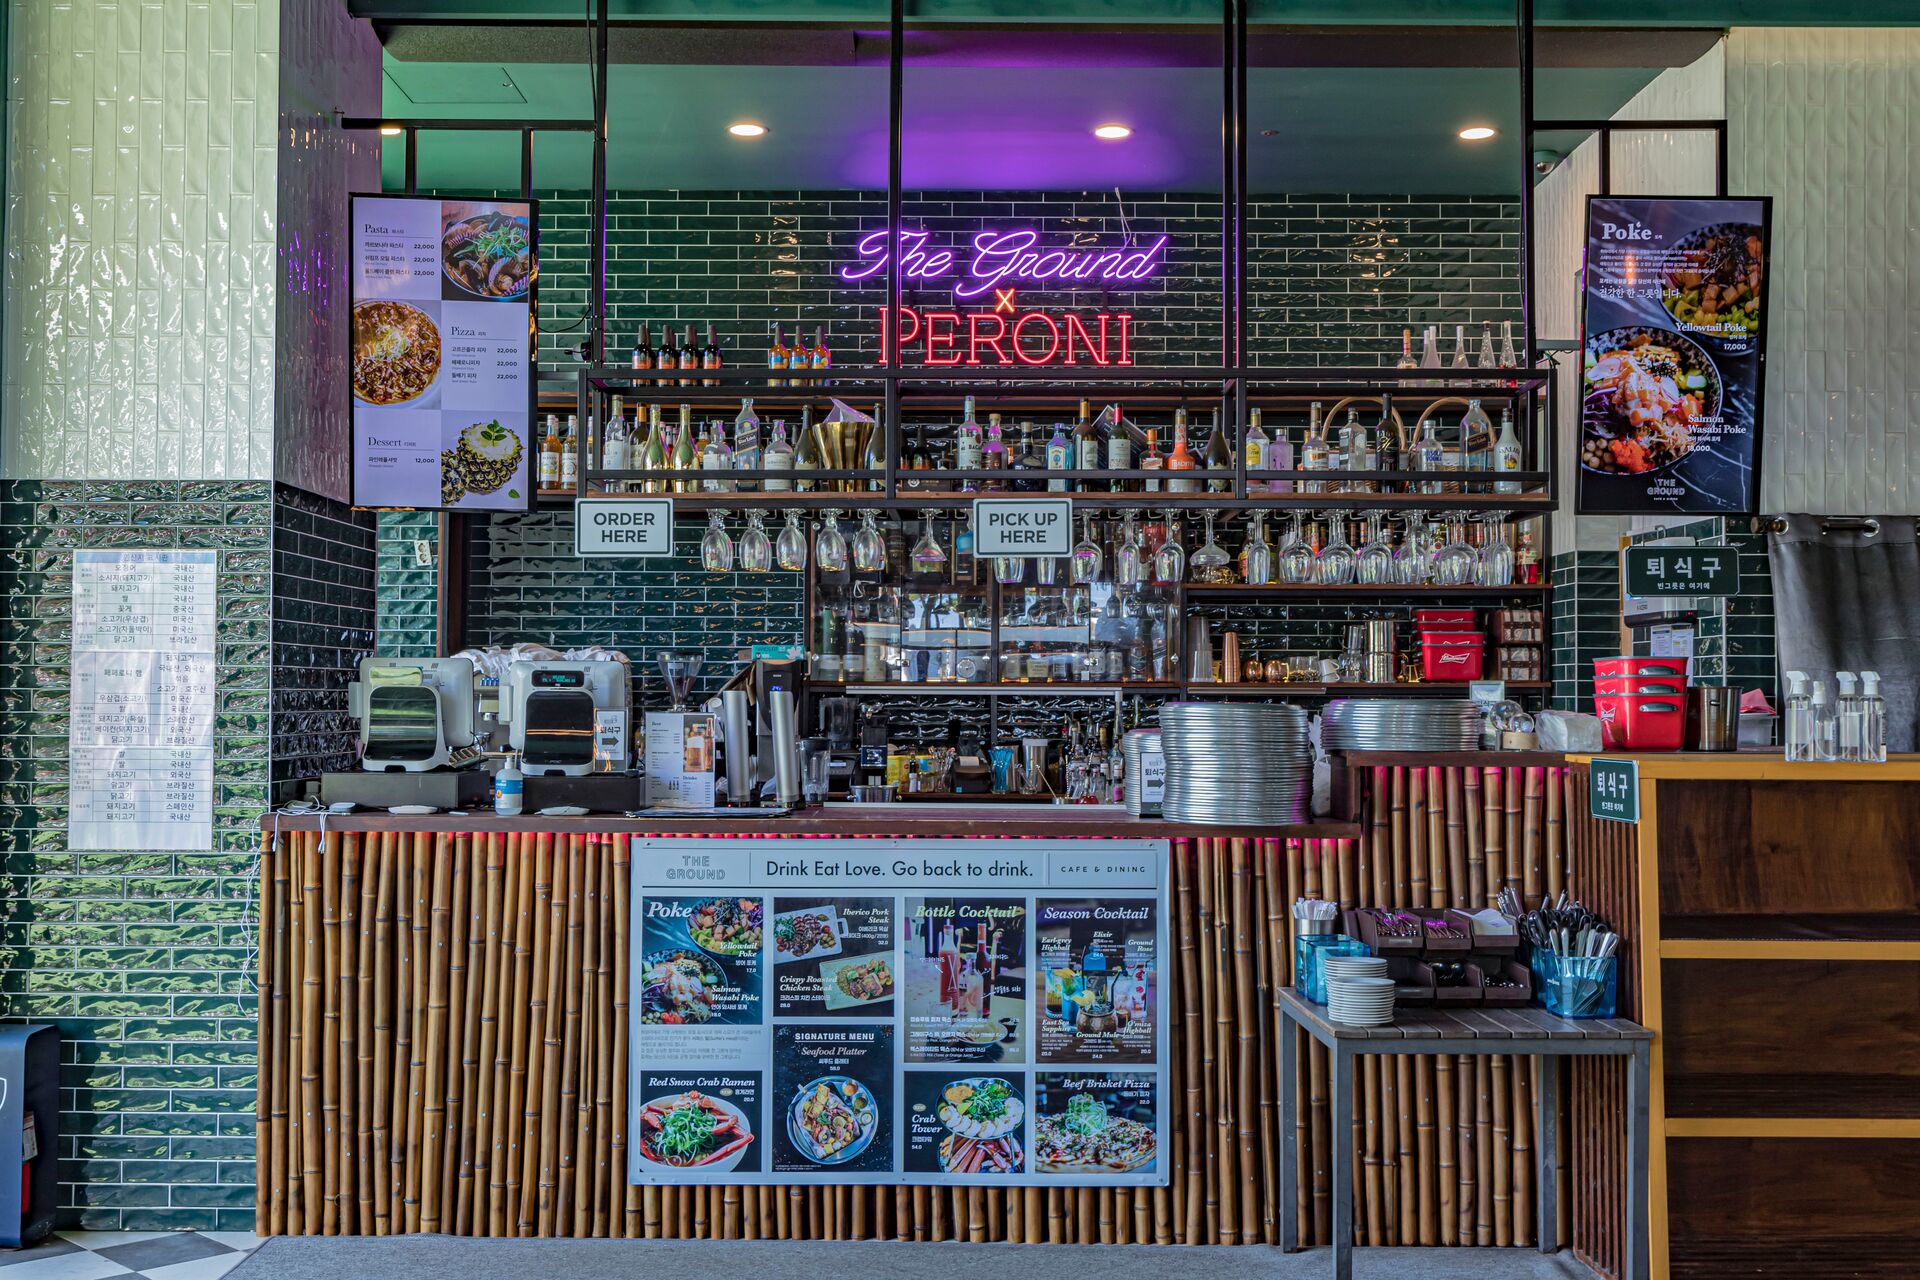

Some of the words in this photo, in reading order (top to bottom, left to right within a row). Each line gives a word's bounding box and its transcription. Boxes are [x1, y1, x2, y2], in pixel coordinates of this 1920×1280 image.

[365, 224, 388, 234] Pasta
[1602, 222, 1652, 240] Poke
[842, 230, 952, 280] The
[956, 230, 1167, 297] Ground
[1626, 288, 1635, 298] 한
[1636, 288, 1682, 298] 그릇입니다.
[451, 326, 475, 336] Pizza
[1676, 322, 1722, 332] Yellowtail
[1724, 322, 1746, 332] Poke
[879, 307, 1132, 364] PERONI
[1688, 414, 1724, 423] Salmon
[1688, 425, 1722, 434] Wasabi
[1724, 425, 1746, 434] Poke
[368, 437, 402, 446] Dessert
[594, 512, 655, 526] ORDER
[990, 513, 1030, 526] PICK
[1034, 513, 1058, 526] UP
[602, 530, 647, 542] HERE
[1000, 530, 1046, 543] HERE
[1646, 556, 1722, 578] 퇴식구
[173, 595, 194, 603] 국내산
[600, 726, 621, 734] 퇴식구
[166, 736, 195, 744] 브라질산
[111, 782, 132, 790] 닭고기
[166, 782, 194, 790] 브라질산
[1598, 772, 1628, 798] 퇴식구
[110, 792, 132, 800] 닭고기
[166, 792, 194, 800] 브라질산
[166, 802, 194, 810] 스페인산
[682, 856, 710, 867] THE
[766, 860, 809, 876] Drink
[815, 862, 840, 876] Eat
[846, 862, 886, 876] Love.
[892, 860, 918, 876] Go
[924, 860, 962, 876] back
[968, 862, 983, 876] to
[988, 860, 1034, 877] drink.
[666, 868, 726, 880] GROUND
[647, 902, 693, 918] Poke
[915, 906, 956, 918] Bottle
[959, 906, 1018, 918] Cocktail
[1044, 907, 1091, 920] Season
[1094, 907, 1149, 920] Cocktail
[780, 976, 806, 984] Crispy
[801, 1046, 836, 1057] Seafood
[836, 1046, 868, 1056] Platter
[648, 1078, 670, 1086] Red
[670, 1078, 696, 1086] Snow
[696, 1078, 720, 1086] Crab
[720, 1078, 756, 1086] Ramen
[1063, 1079, 1084, 1090] Beef
[1086, 1079, 1122, 1088] Brisket
[1124, 1080, 1150, 1088] Pizza
[912, 1114, 936, 1124] Crab
[912, 1124, 942, 1134] Tower
